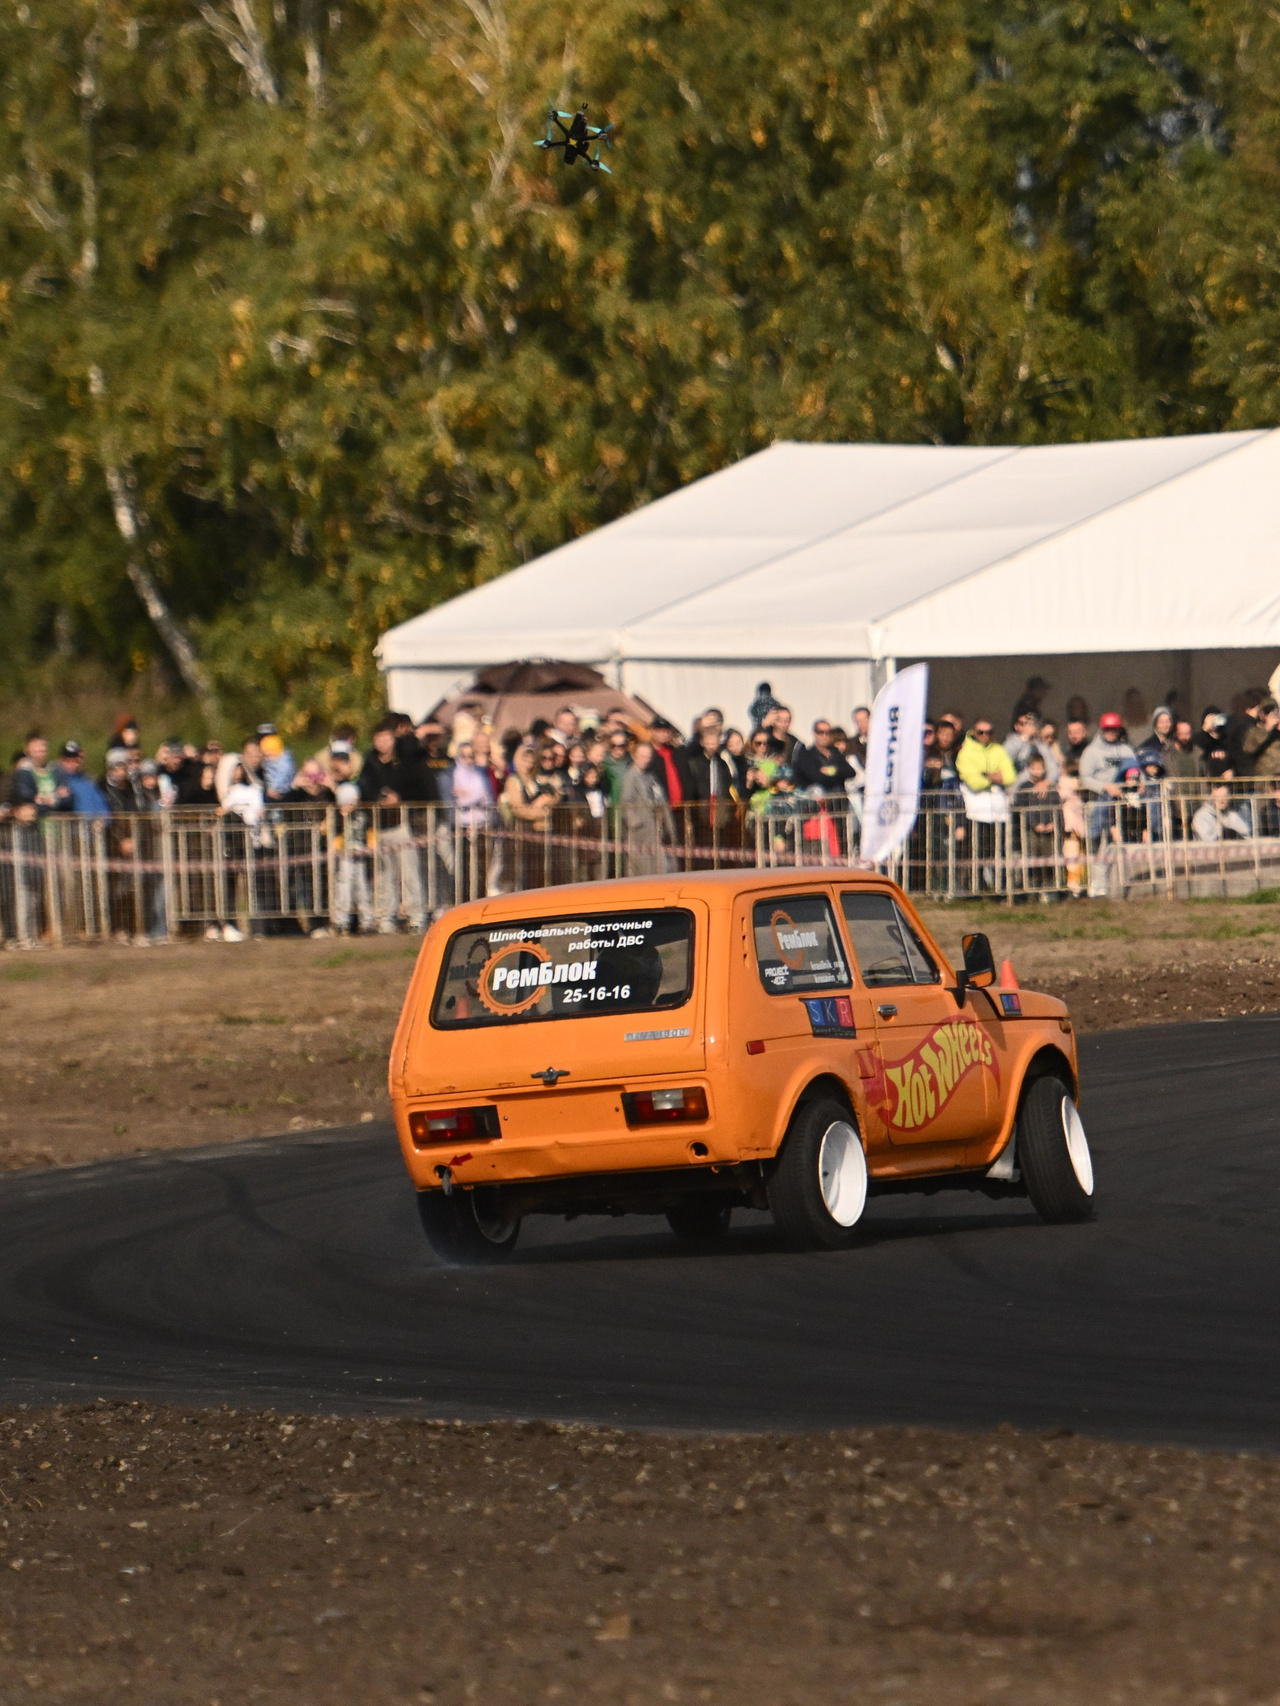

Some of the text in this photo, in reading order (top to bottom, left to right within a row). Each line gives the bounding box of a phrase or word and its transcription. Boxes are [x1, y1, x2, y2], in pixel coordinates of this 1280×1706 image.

[488, 919, 653, 943] Шлифовально-расточные
[568, 934, 645, 953] работы ДВС
[492, 960, 598, 991] РемБлок
[562, 984, 631, 1004] 25-16-16
[808, 1000, 851, 1023] SKR
